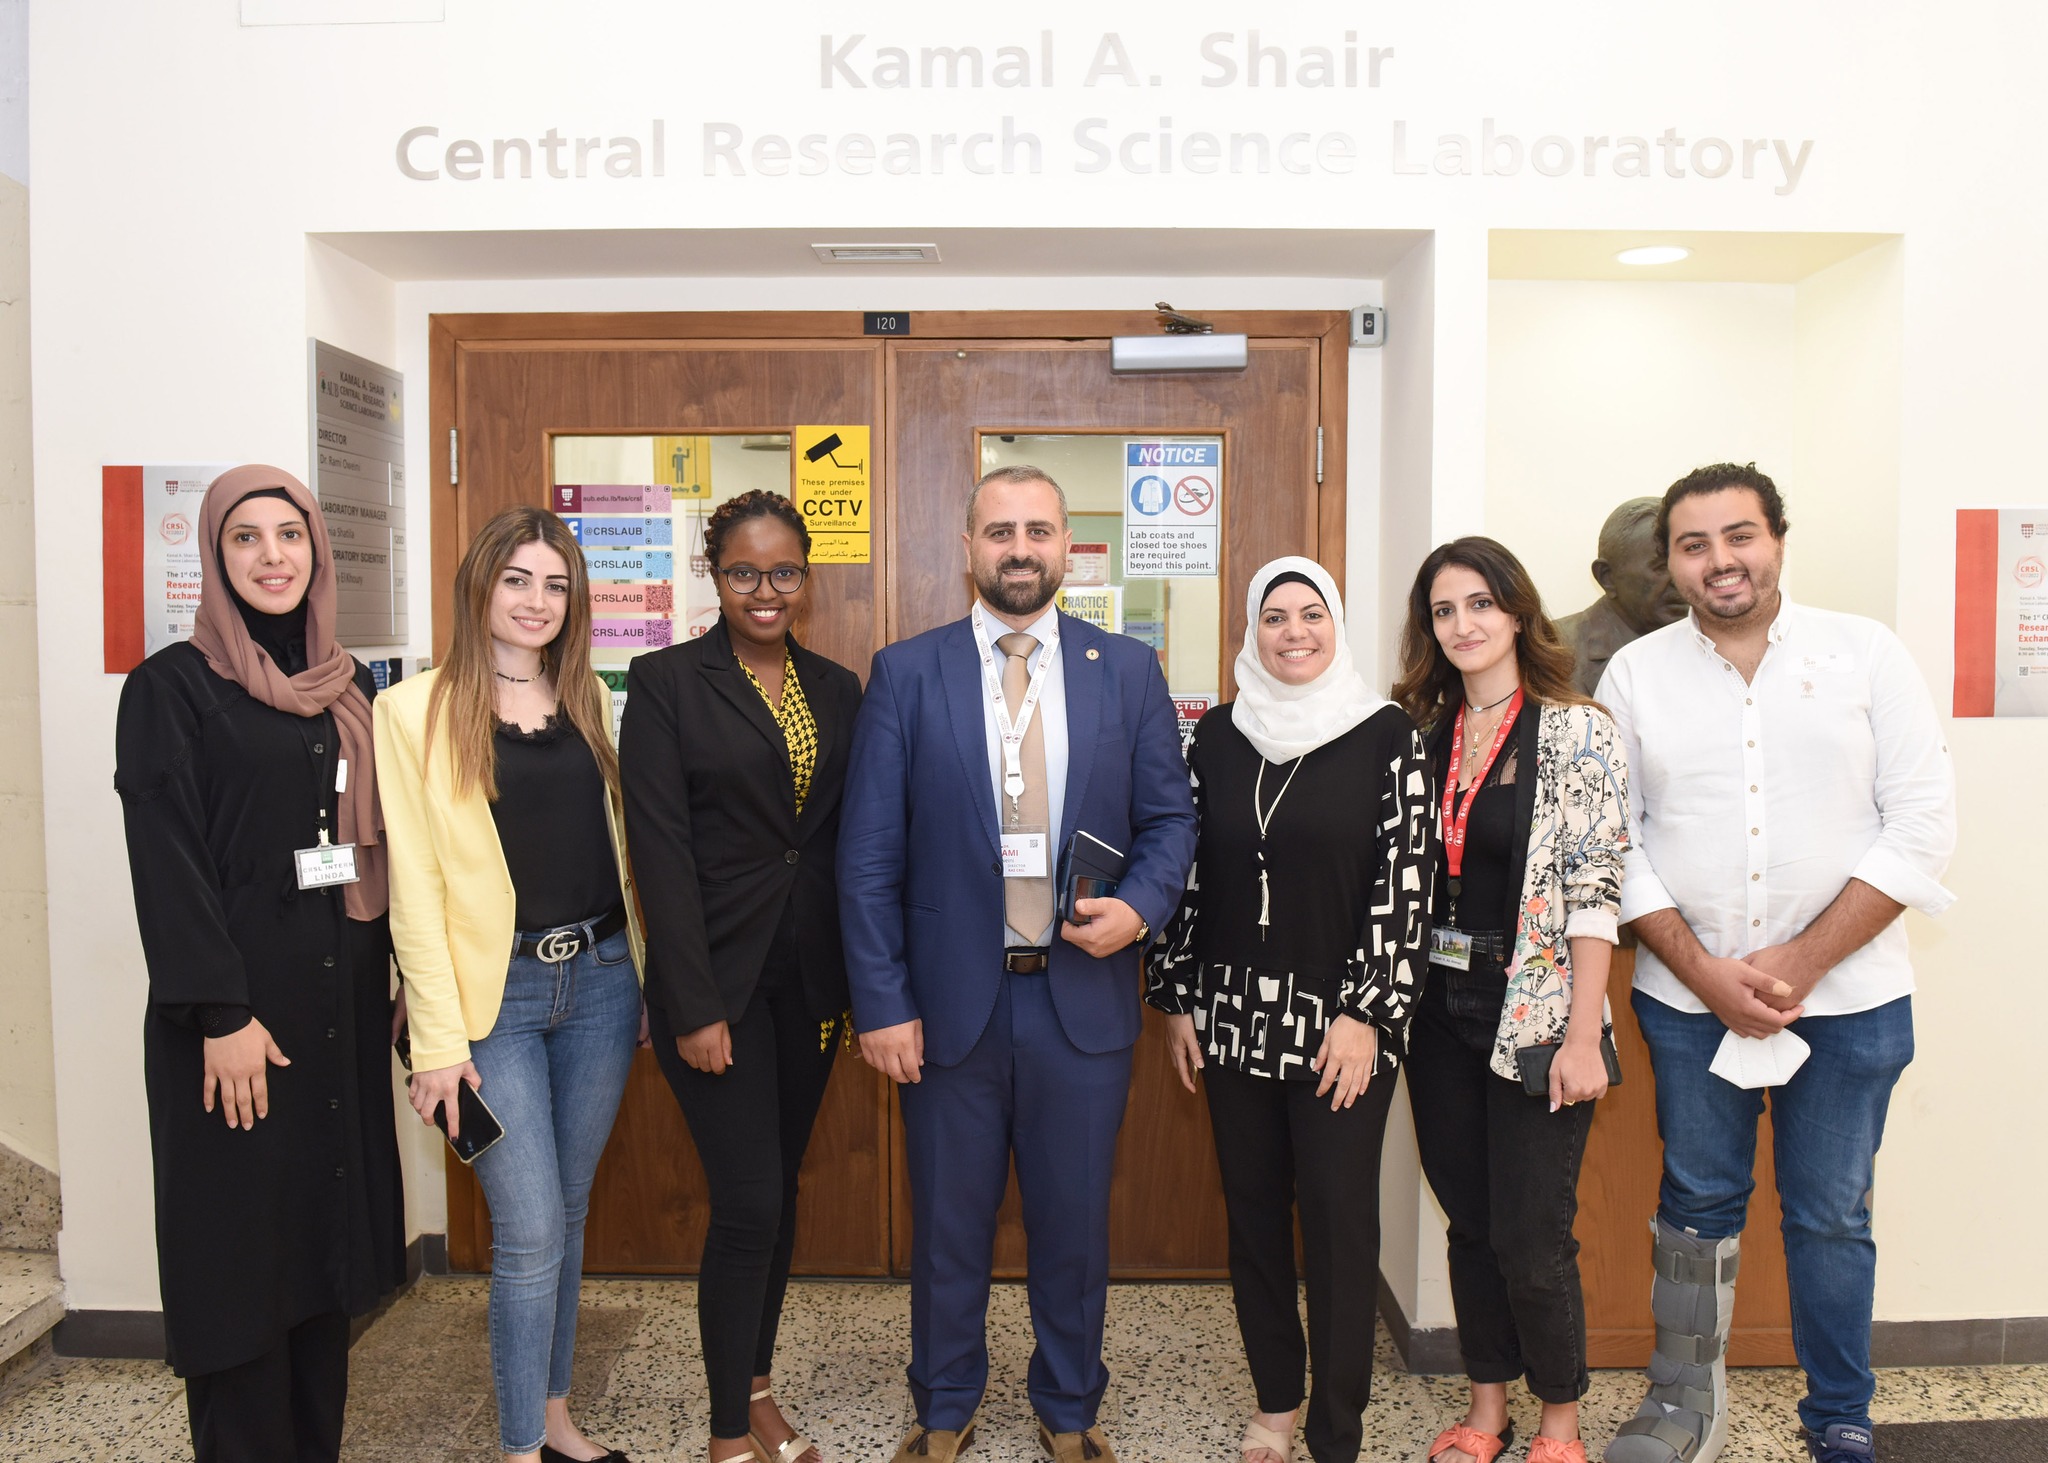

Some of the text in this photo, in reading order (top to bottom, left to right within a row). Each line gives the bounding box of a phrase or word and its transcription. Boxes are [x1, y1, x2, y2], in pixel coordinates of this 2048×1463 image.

[819, 30, 1394, 89] Kamal A. Shair
[396, 116, 1815, 196] Central Research Science Laboratory
[877, 317, 896, 330] 120
[340, 371, 361, 389] KAMAL
[369, 382, 385, 396] SHAIR
[340, 385, 385, 408] CENTRAL RESEARCH
[340, 399, 385, 421] SCIENCE LABORATORY
[318, 428, 347, 445] DIRECTOR
[1138, 447, 1206, 463] NOTICE
[329, 456, 342, 468] Rami
[829, 479, 865, 487] premises
[321, 501, 387, 521] LABORATORY MANAGER
[803, 499, 863, 516] CCTV
[809, 519, 857, 527] Surveillance
[584, 527, 643, 536] @CRSLAUB
[1130, 531, 1147, 539] Lab
[1177, 531, 1195, 539] and
[1130, 541, 1160, 549] closed
[1180, 541, 1207, 549] shoes
[333, 550, 387, 565] ORATORY SCIENTIST
[1147, 551, 1186, 561] required
[586, 560, 643, 569] @CRSLAUB
[1130, 561, 1211, 571] beyond this point.
[166, 580, 201, 589] Researc
[166, 591, 202, 601] Exchang
[1061, 596, 1108, 608] PRACTICE
[1062, 610, 1108, 626] CIAL
[2018, 624, 2048, 632] Resear
[2018, 634, 2048, 643] Exchan
[1002, 849, 1019, 857] AMI
[303, 861, 354, 873] CRSL INTERN
[314, 871, 345, 881] LINDA
[1841, 1431, 1869, 1444] adidas
